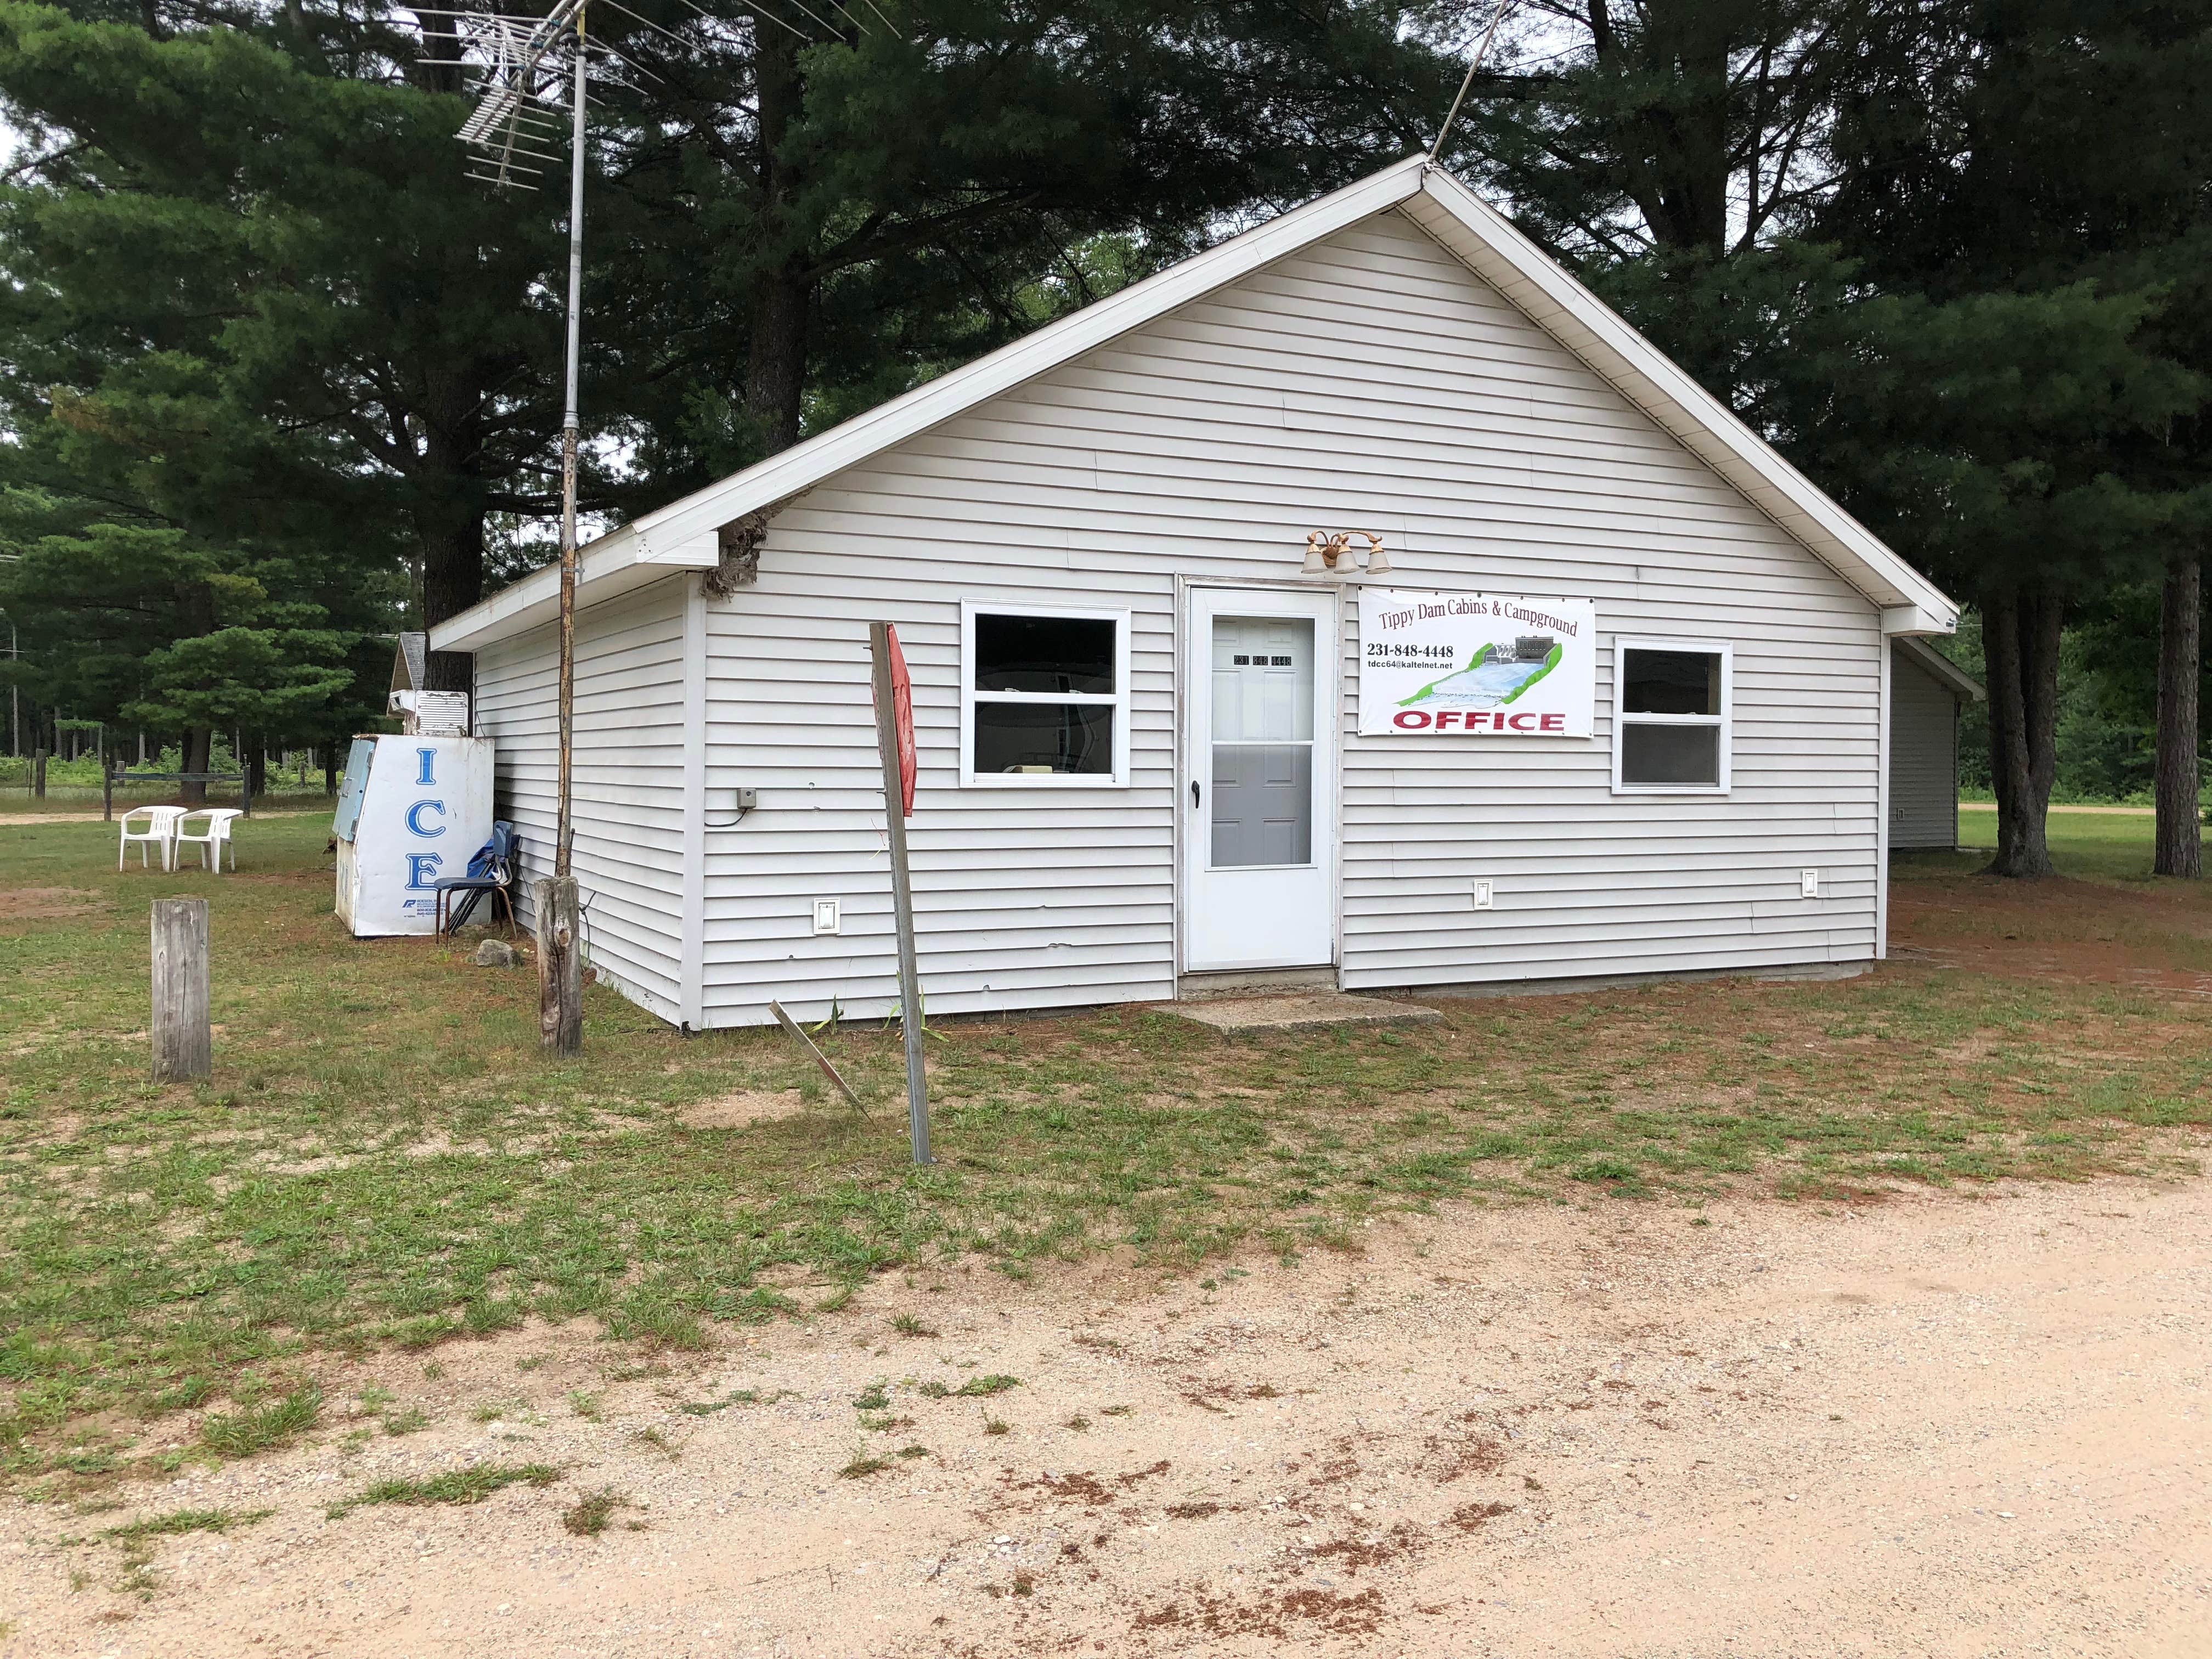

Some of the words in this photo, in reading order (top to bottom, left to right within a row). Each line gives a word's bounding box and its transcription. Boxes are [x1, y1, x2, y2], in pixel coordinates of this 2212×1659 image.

[1379, 609, 1415, 630] Tippy
[1418, 603, 1446, 619] Dam
[1447, 598, 1487, 615] Cabins
[1492, 601, 1501, 616] &
[1504, 602, 1577, 637] Campground
[1367, 643, 1453, 658] 231-848-4448
[1234, 655, 1248, 665] 231
[1253, 656, 1267, 665] 848
[1272, 657, 1291, 665] 4448
[1368, 660, 1453, 669] tdcc64@kaltelnet.net
[1393, 710, 1566, 731] OFFICE
[405, 748, 445, 891] ICE
